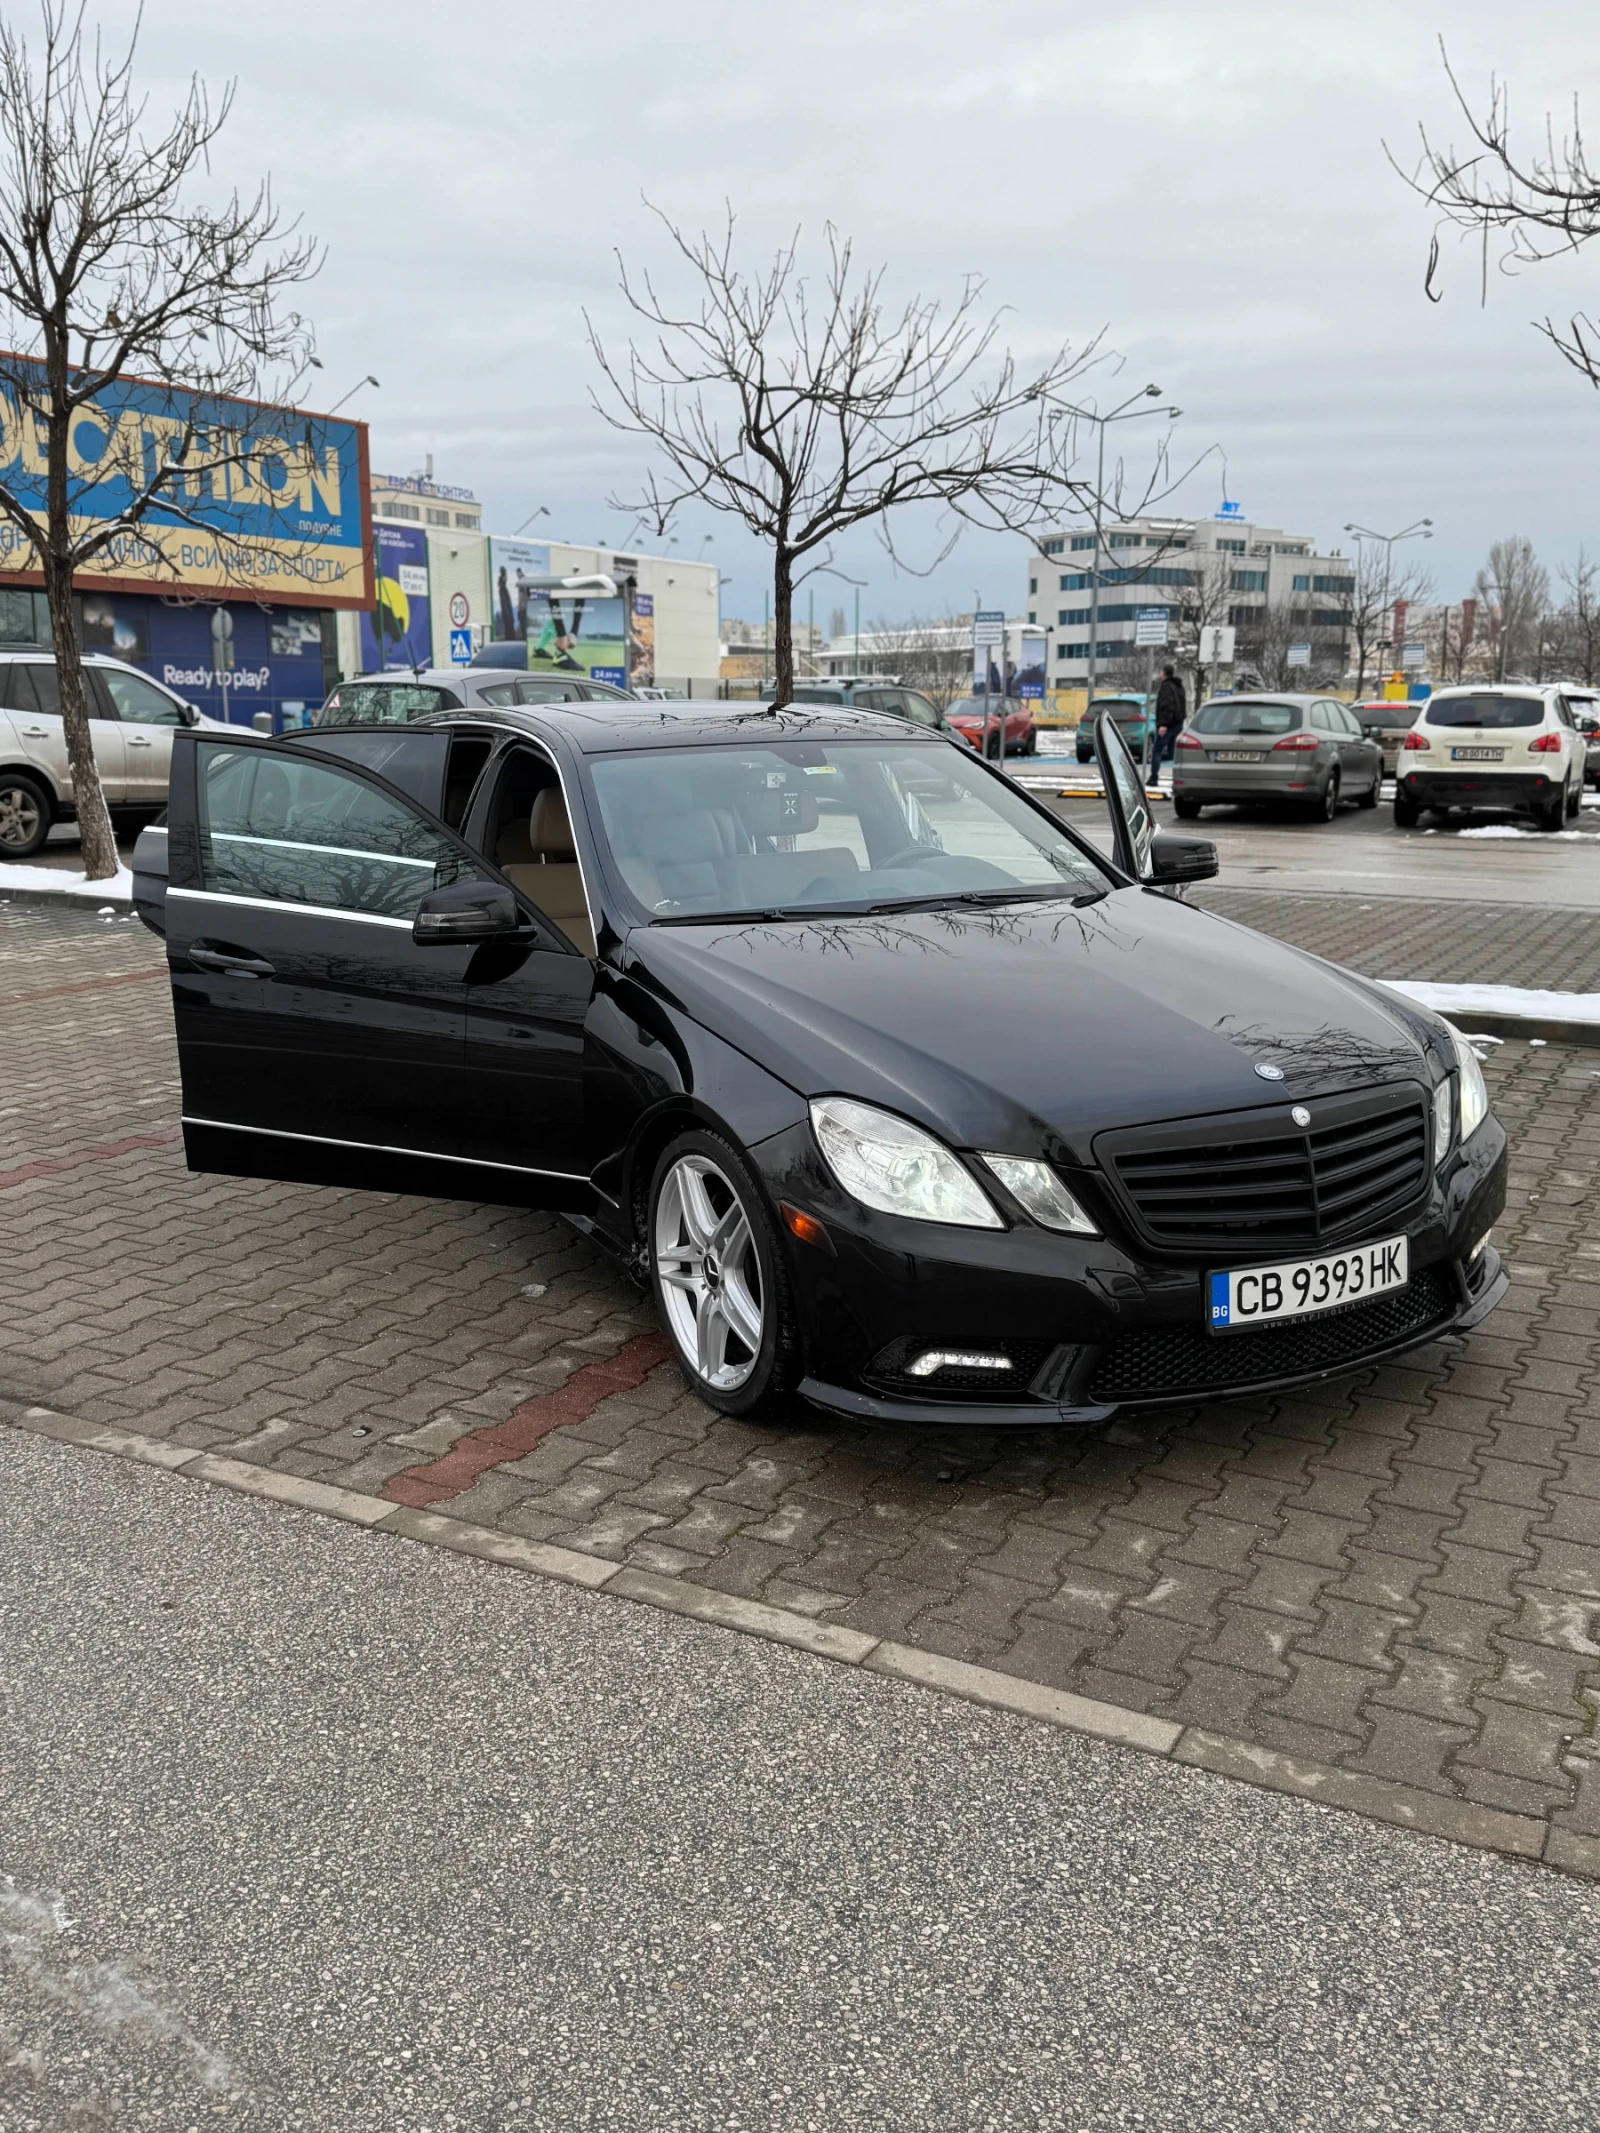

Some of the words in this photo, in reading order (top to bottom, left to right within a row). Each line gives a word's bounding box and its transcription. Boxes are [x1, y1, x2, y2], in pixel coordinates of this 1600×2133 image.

[181, 544, 254, 574] ВСИЧКО
[257, 551, 279, 575] ЗА
[282, 553, 345, 580] СПОРТА
[453, 600, 465, 619] 20
[163, 664, 213, 690] Ready
[215, 669, 232, 686] to
[233, 667, 270, 691] play?
[1236, 1271, 1283, 1315] CB
[1292, 1254, 1365, 1307] 9393
[1370, 1241, 1402, 1288] HK
[1212, 1305, 1229, 1318] BG
